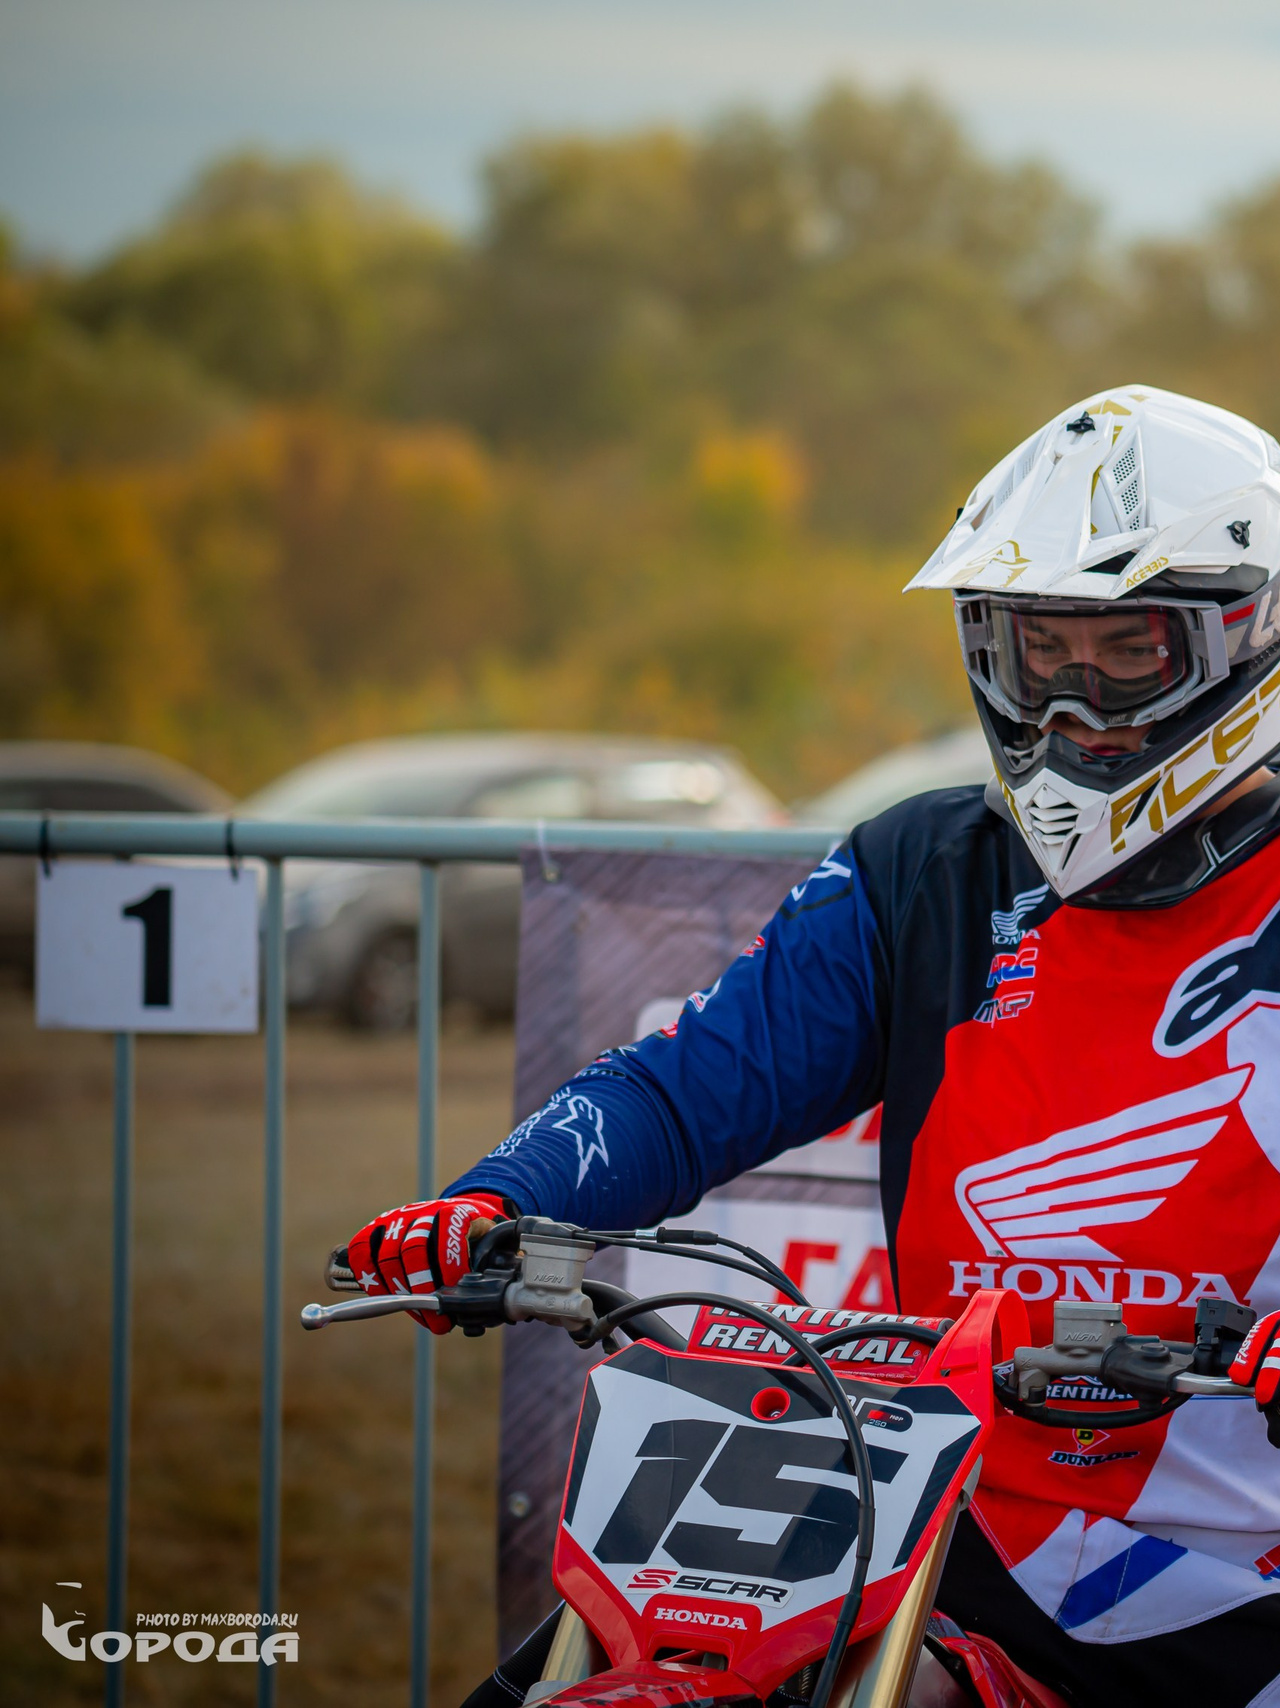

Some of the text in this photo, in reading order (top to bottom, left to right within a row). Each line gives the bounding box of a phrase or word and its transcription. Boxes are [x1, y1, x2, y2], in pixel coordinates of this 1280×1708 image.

[122, 887, 173, 1007] 1
[948, 1261, 1250, 1307] HONDA
[1049, 1451, 1139, 1467] DUNLOP
[592, 1418, 909, 1583] 15
[673, 1575, 788, 1603] SCAR
[654, 1607, 748, 1630] HONDA
